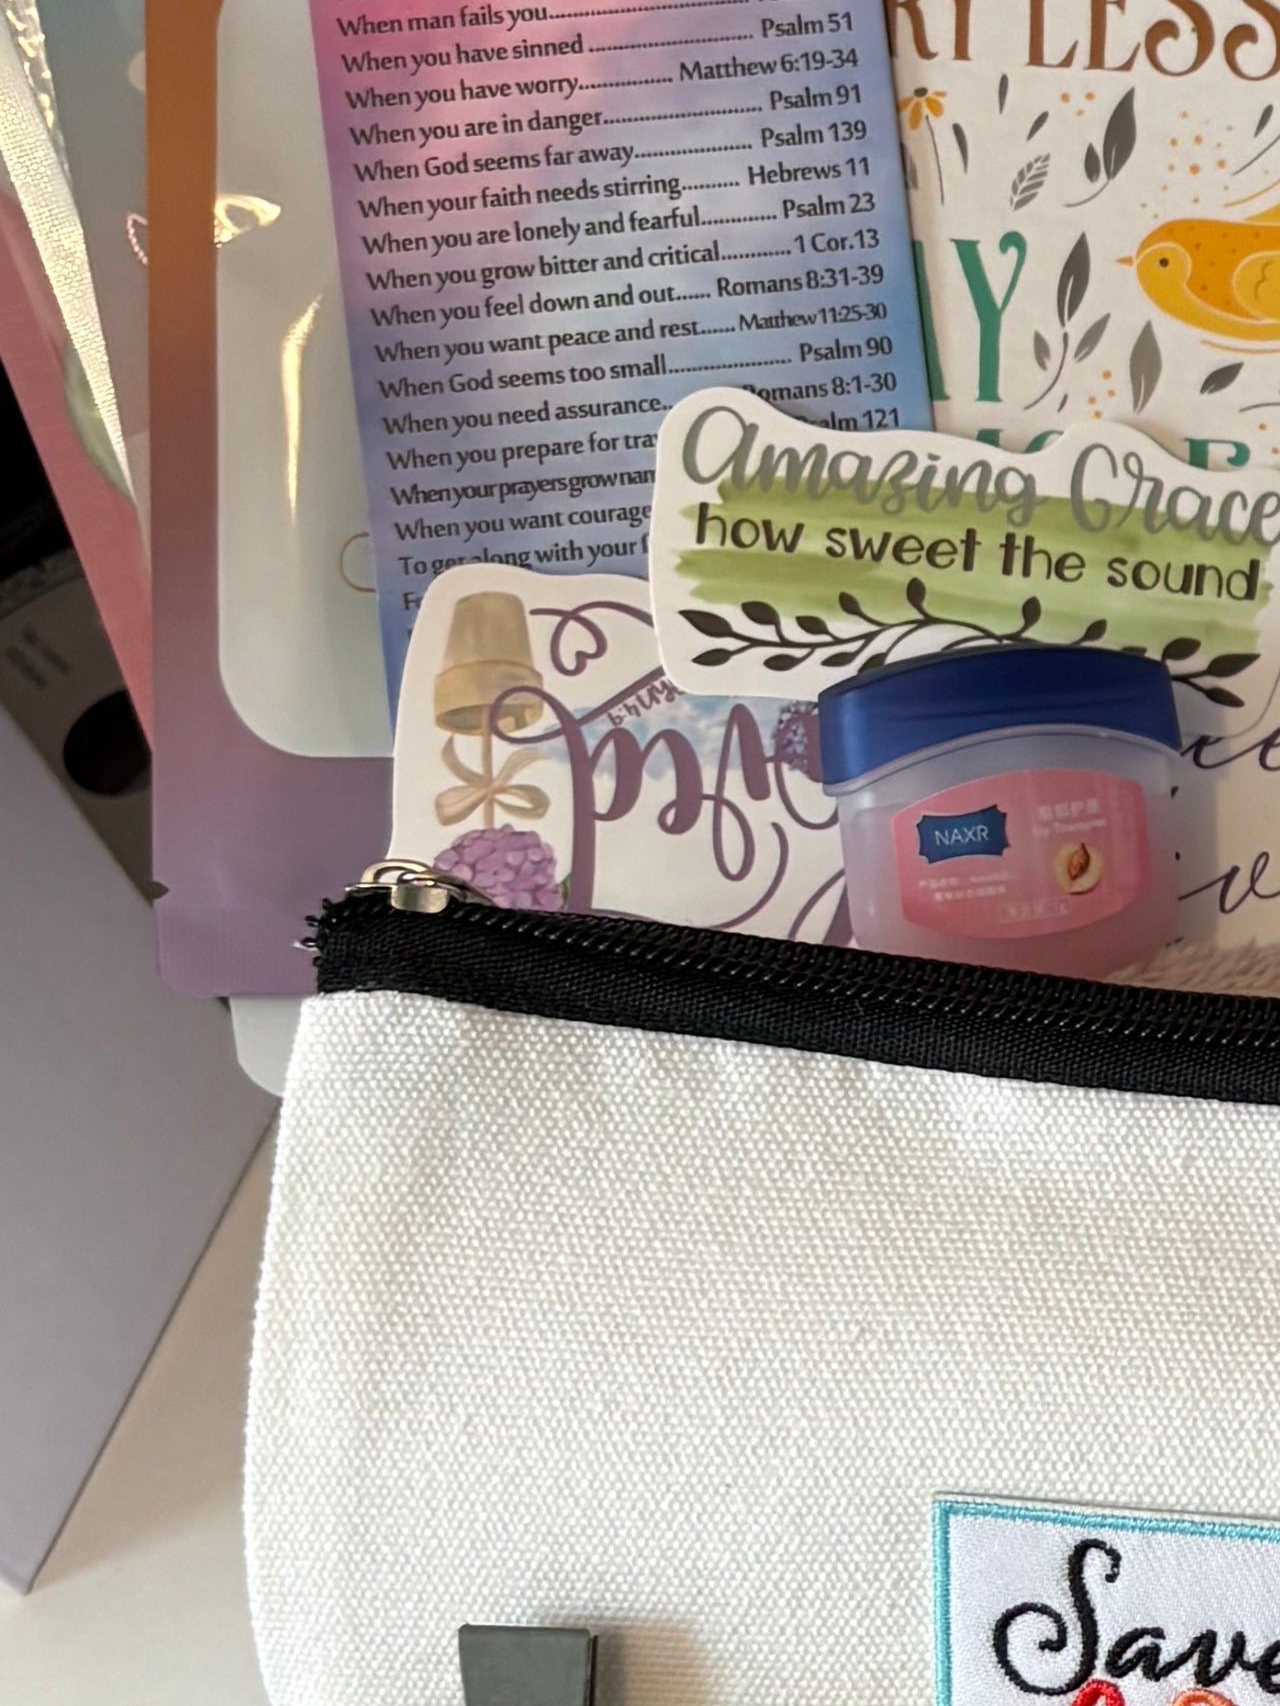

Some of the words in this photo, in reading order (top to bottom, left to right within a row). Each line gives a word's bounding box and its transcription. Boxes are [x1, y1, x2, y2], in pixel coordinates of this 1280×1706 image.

[335, 13, 402, 36] When
[407, 14, 455, 31] man
[459, 3, 504, 26] fails
[507, 6, 549, 32] you
[340, 50, 407, 72] When
[410, 51, 451, 76] you
[454, 42, 508, 64] have
[510, 31, 583, 59] sinned
[760, 13, 824, 38] Psalm
[827, 11, 852, 32] 51
[344, 86, 411, 109] When
[414, 87, 455, 112] you
[459, 78, 512, 100] have
[514, 76, 579, 100] worry
[679, 55, 777, 81] Matthew
[780, 47, 858, 72] 6:19-34
[349, 123, 416, 145] When
[418, 123, 460, 148] you
[464, 120, 498, 137] are
[500, 112, 523, 133] in
[526, 109, 604, 136] danger
[769, 85, 832, 110] Psalm
[835, 83, 861, 105] 91
[353, 159, 419, 182] When
[423, 151, 469, 176] God
[472, 153, 541, 172] seems
[543, 143, 573, 166] far
[577, 145, 635, 168] away
[760, 122, 824, 148] Psalm
[827, 119, 867, 142] 139
[357, 195, 423, 218] When
[426, 195, 477, 221] your
[480, 183, 531, 208] faith
[535, 177, 600, 204] needs
[602, 173, 682, 201] stirring
[747, 160, 841, 185] Hebrews
[844, 156, 869, 176] 11
[361, 231, 428, 254] When
[430, 232, 472, 257] you
[476, 228, 510, 245] are
[513, 216, 580, 245] lonely
[583, 210, 625, 236] and
[627, 204, 701, 232] fearful
[781, 193, 845, 219] Psalm
[848, 191, 875, 213] 23
[378, 377, 444, 398] When
[448, 368, 493, 392] God
[497, 369, 566, 388] seems
[567, 365, 606, 382] too
[609, 352, 666, 379] small
[798, 337, 862, 362] Psalm
[865, 335, 892, 356] 90
[680, 406, 1048, 527] Amazing
[694, 501, 806, 553] how
[825, 525, 981, 574] sweet
[999, 532, 1087, 585] the
[1106, 556, 1262, 604] sound
[933, 821, 992, 849] NAXR
